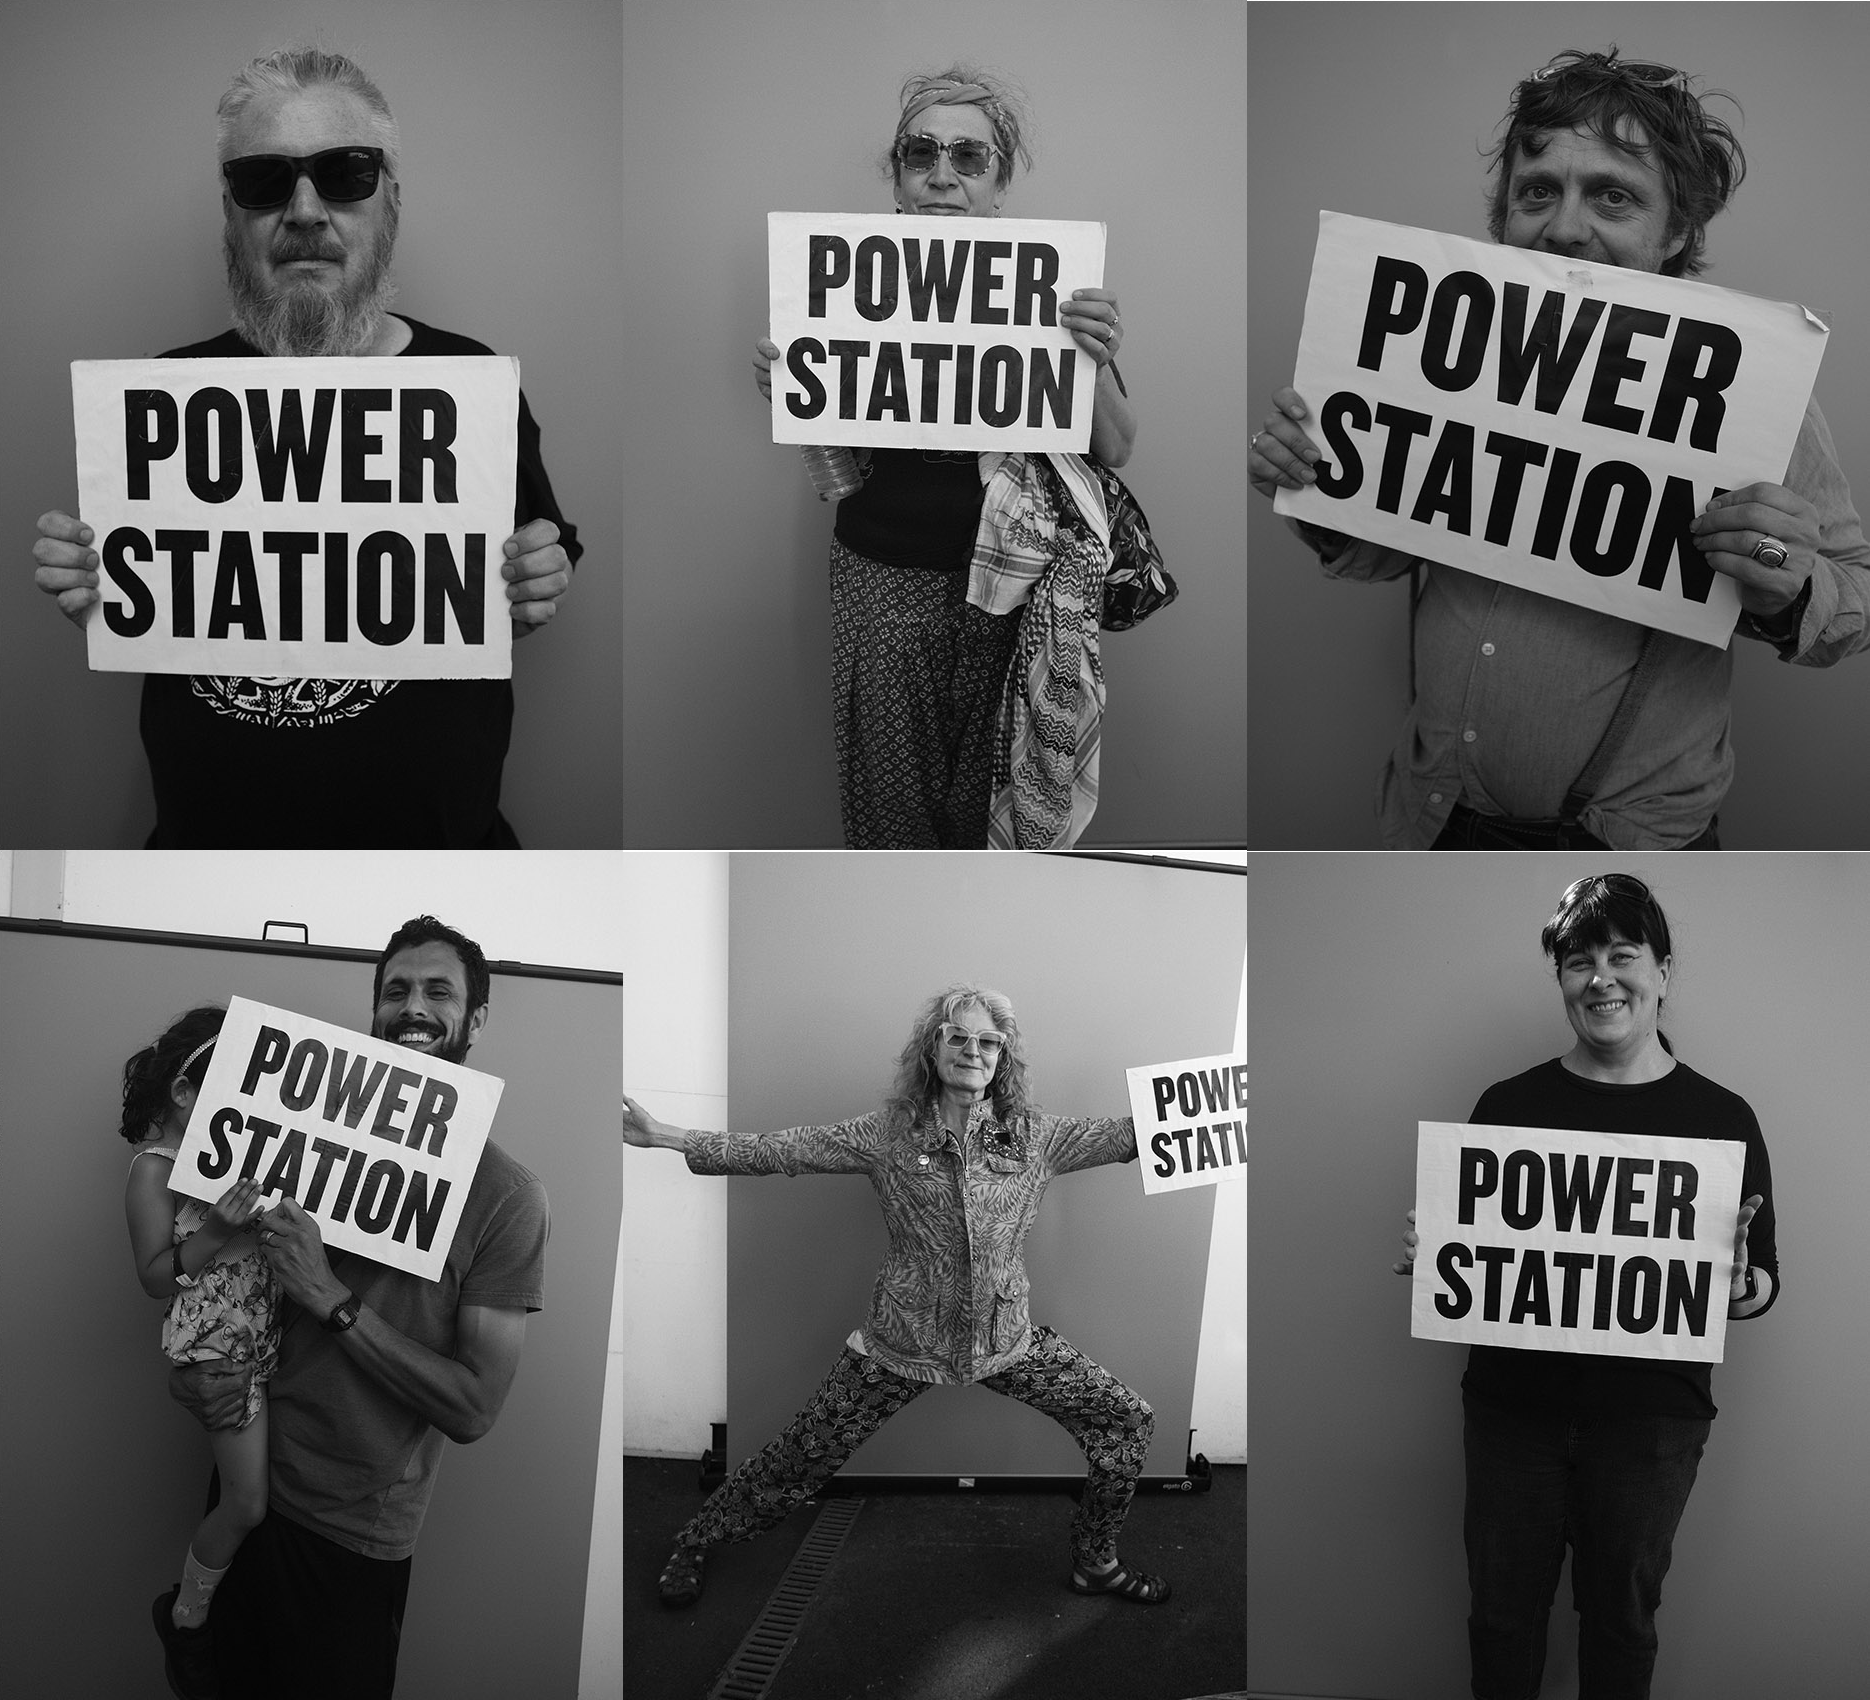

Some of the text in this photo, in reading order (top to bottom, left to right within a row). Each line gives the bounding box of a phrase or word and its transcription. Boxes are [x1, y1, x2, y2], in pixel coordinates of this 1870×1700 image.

[809, 235, 1059, 327] POWER
[786, 337, 1076, 429] STATION
[1357, 256, 1742, 453] POWER
[125, 387, 458, 503] POWER
[1312, 390, 1743, 604] STATION
[102, 527, 486, 646] STATION
[240, 1025, 458, 1158] POWER
[1151, 1120, 1247, 1178] STATI
[197, 1107, 452, 1252] STATION
[1458, 1147, 1698, 1240] POWER
[1435, 1242, 1712, 1337] STATION
